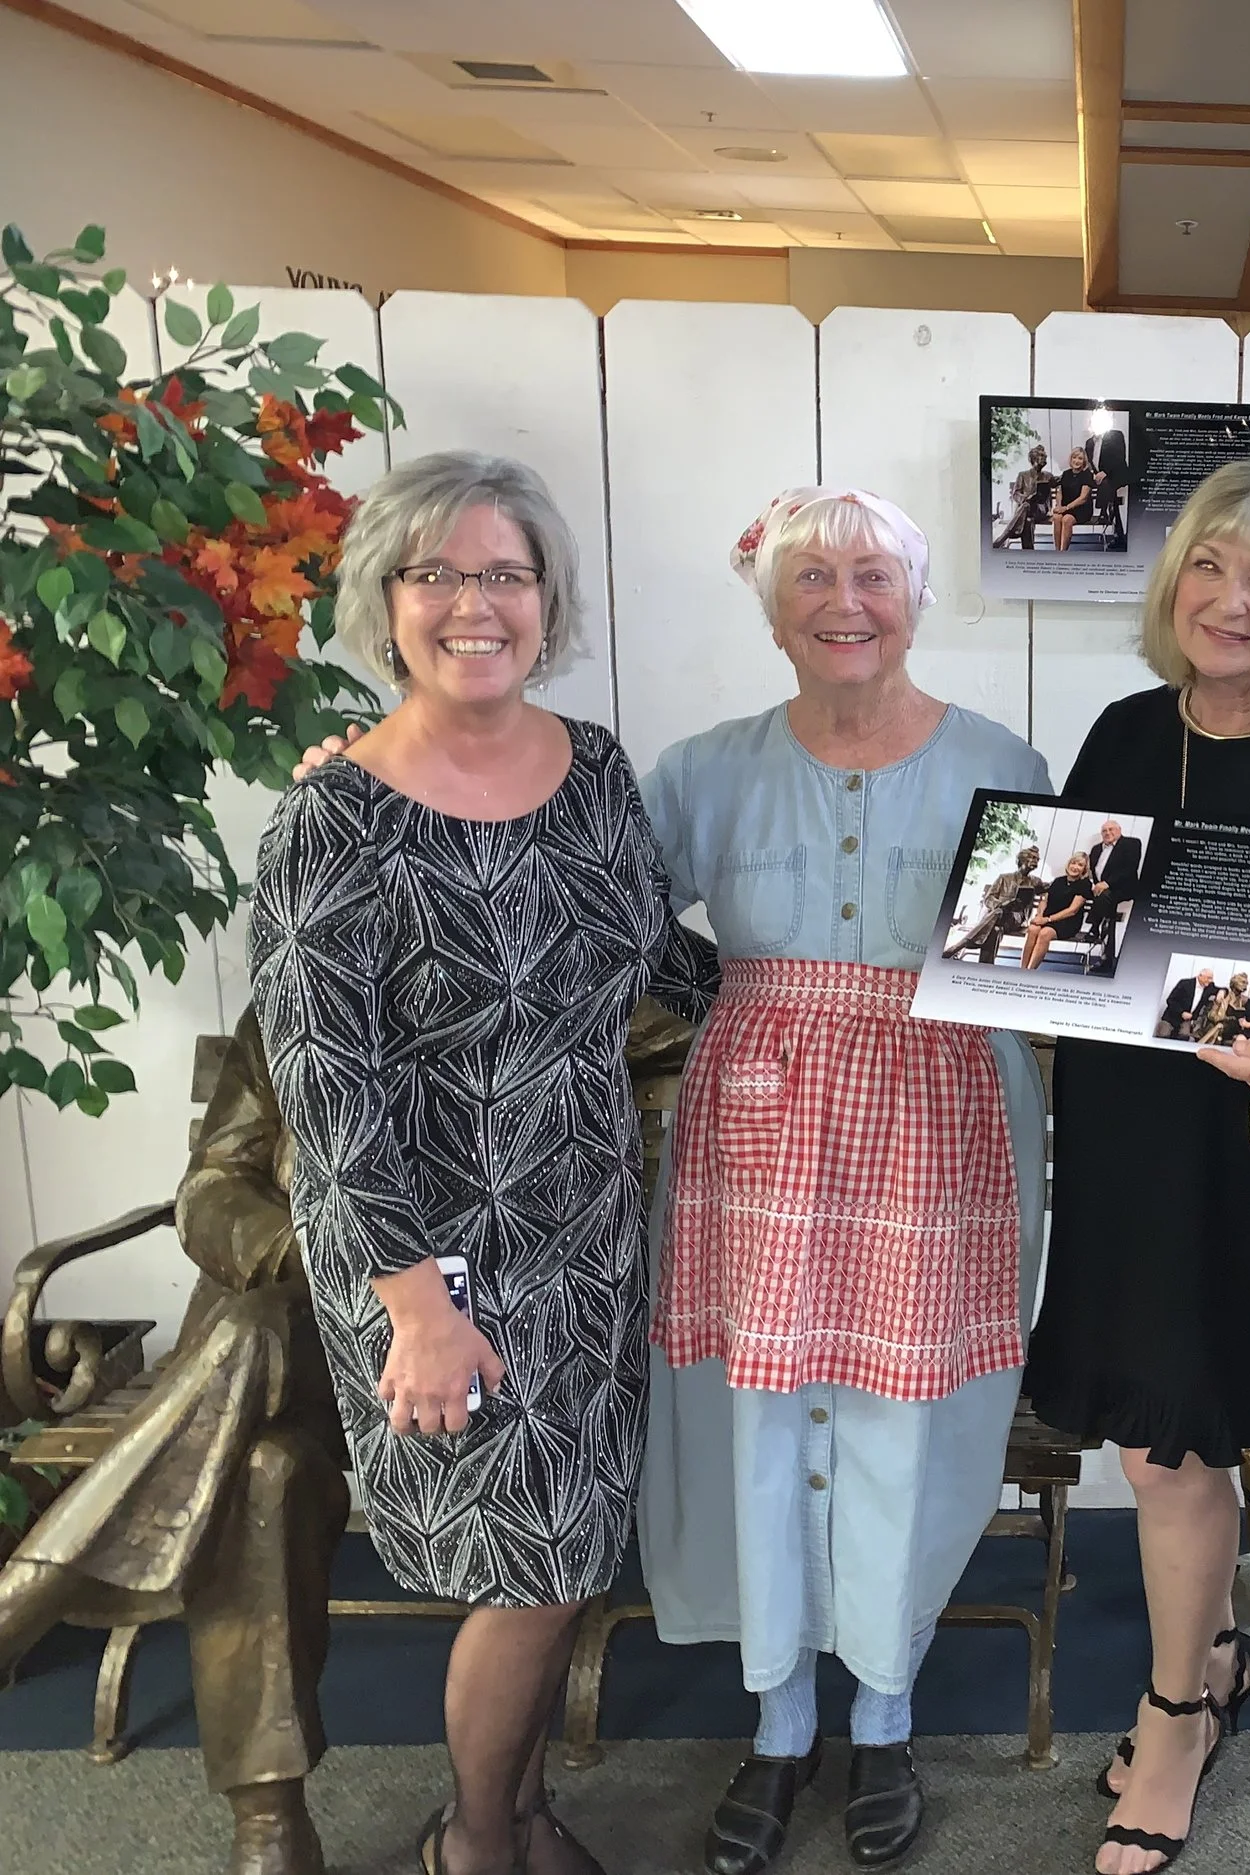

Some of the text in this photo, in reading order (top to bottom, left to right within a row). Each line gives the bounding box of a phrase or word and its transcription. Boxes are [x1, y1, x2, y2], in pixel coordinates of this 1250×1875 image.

[1174, 820, 1183, 829] Mr.
[1185, 820, 1199, 829] Mark
[1201, 822, 1218, 830] Twain
[1220, 824, 1238, 834] Finally
